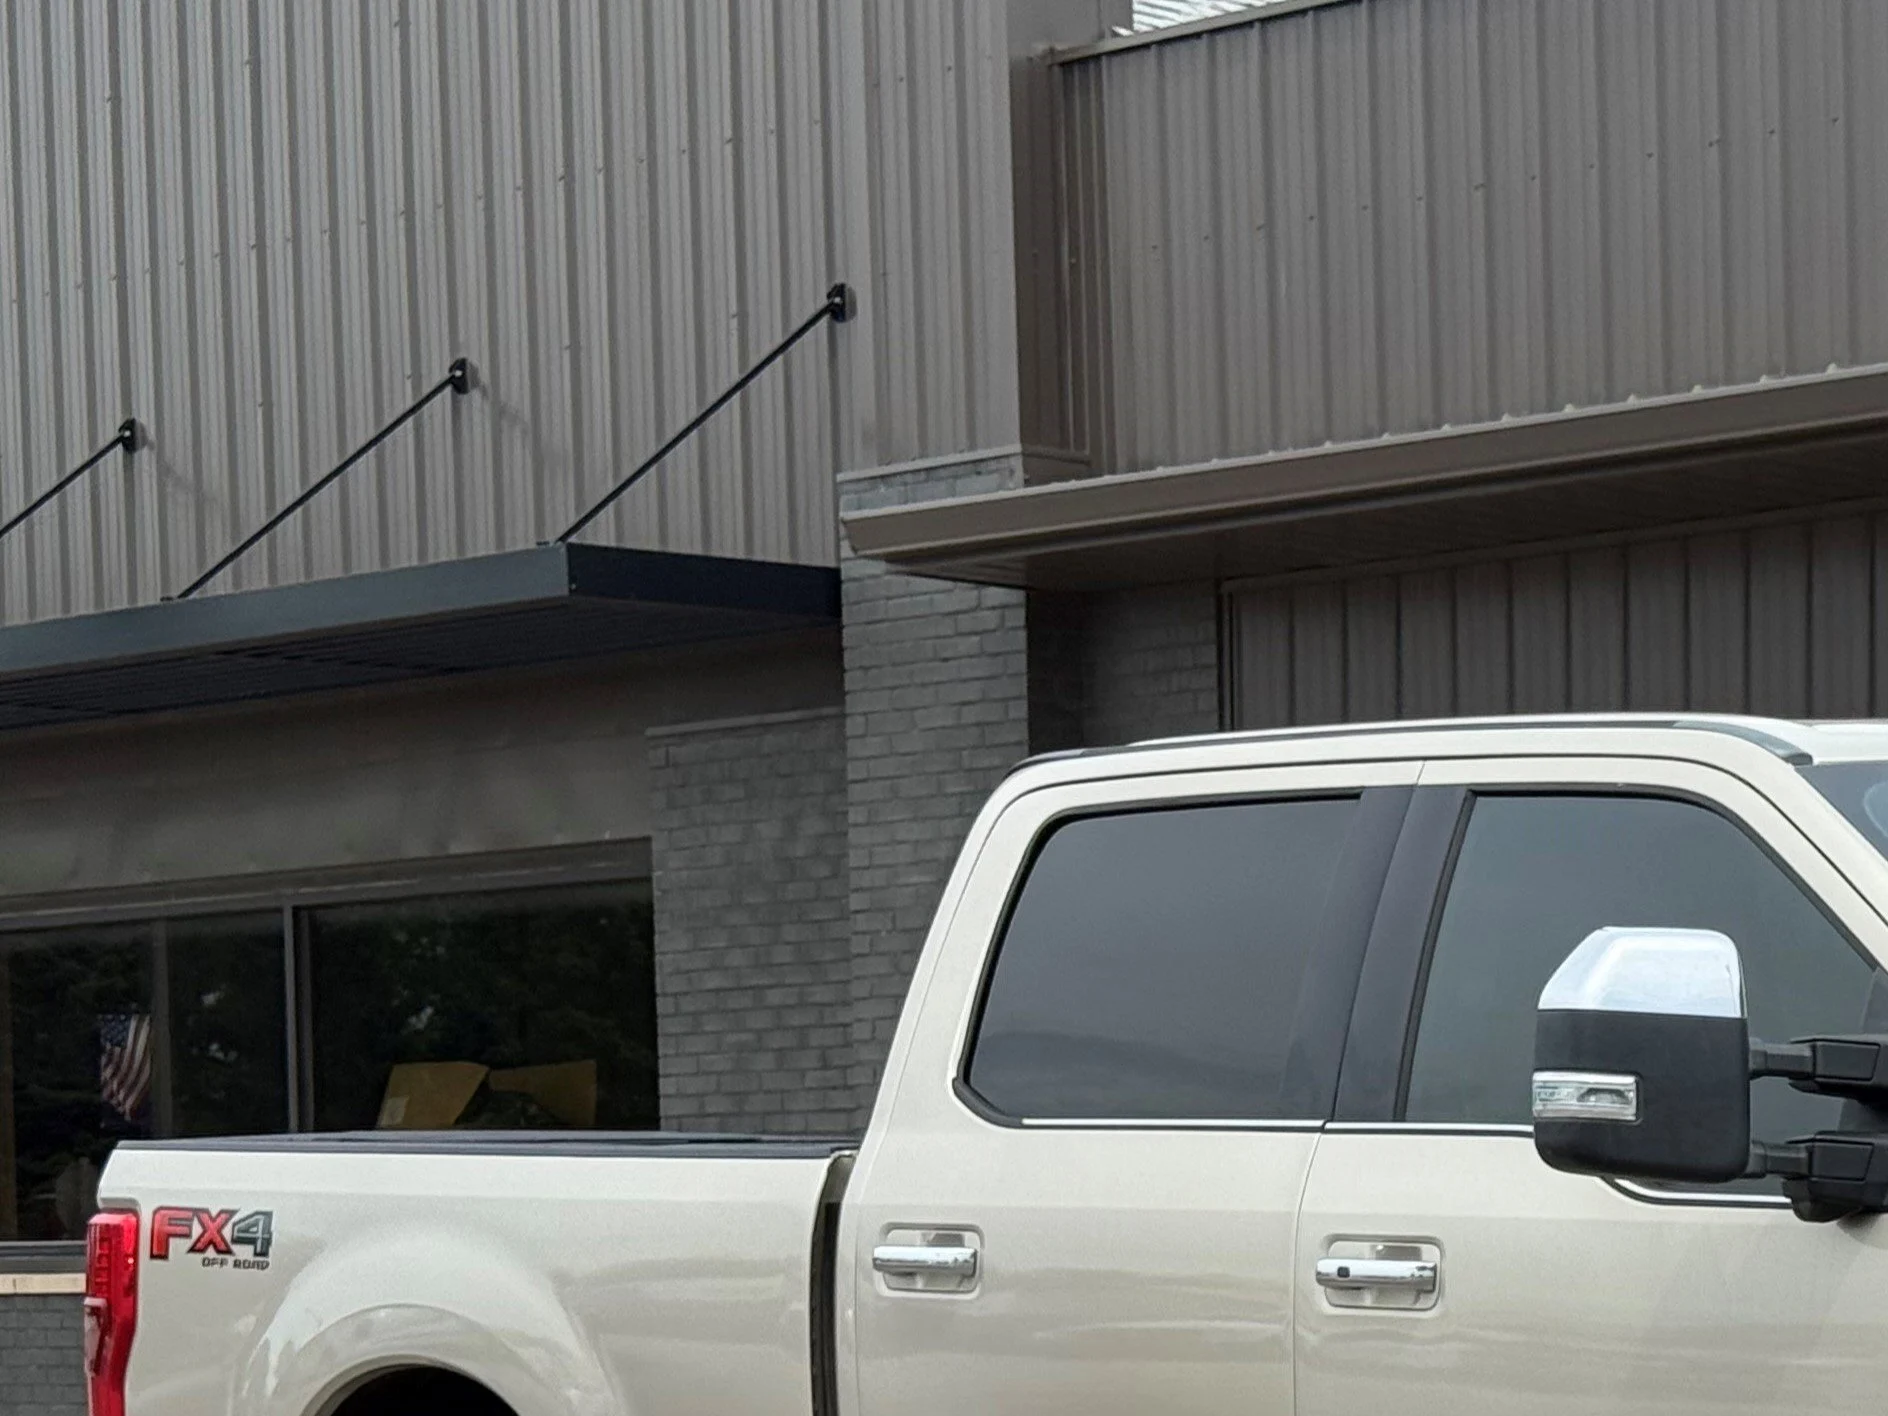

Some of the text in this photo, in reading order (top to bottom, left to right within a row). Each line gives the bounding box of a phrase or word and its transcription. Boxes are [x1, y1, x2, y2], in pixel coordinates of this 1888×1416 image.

[150, 1206, 273, 1260] FX4
[202, 1256, 270, 1270] OFF ROAD
